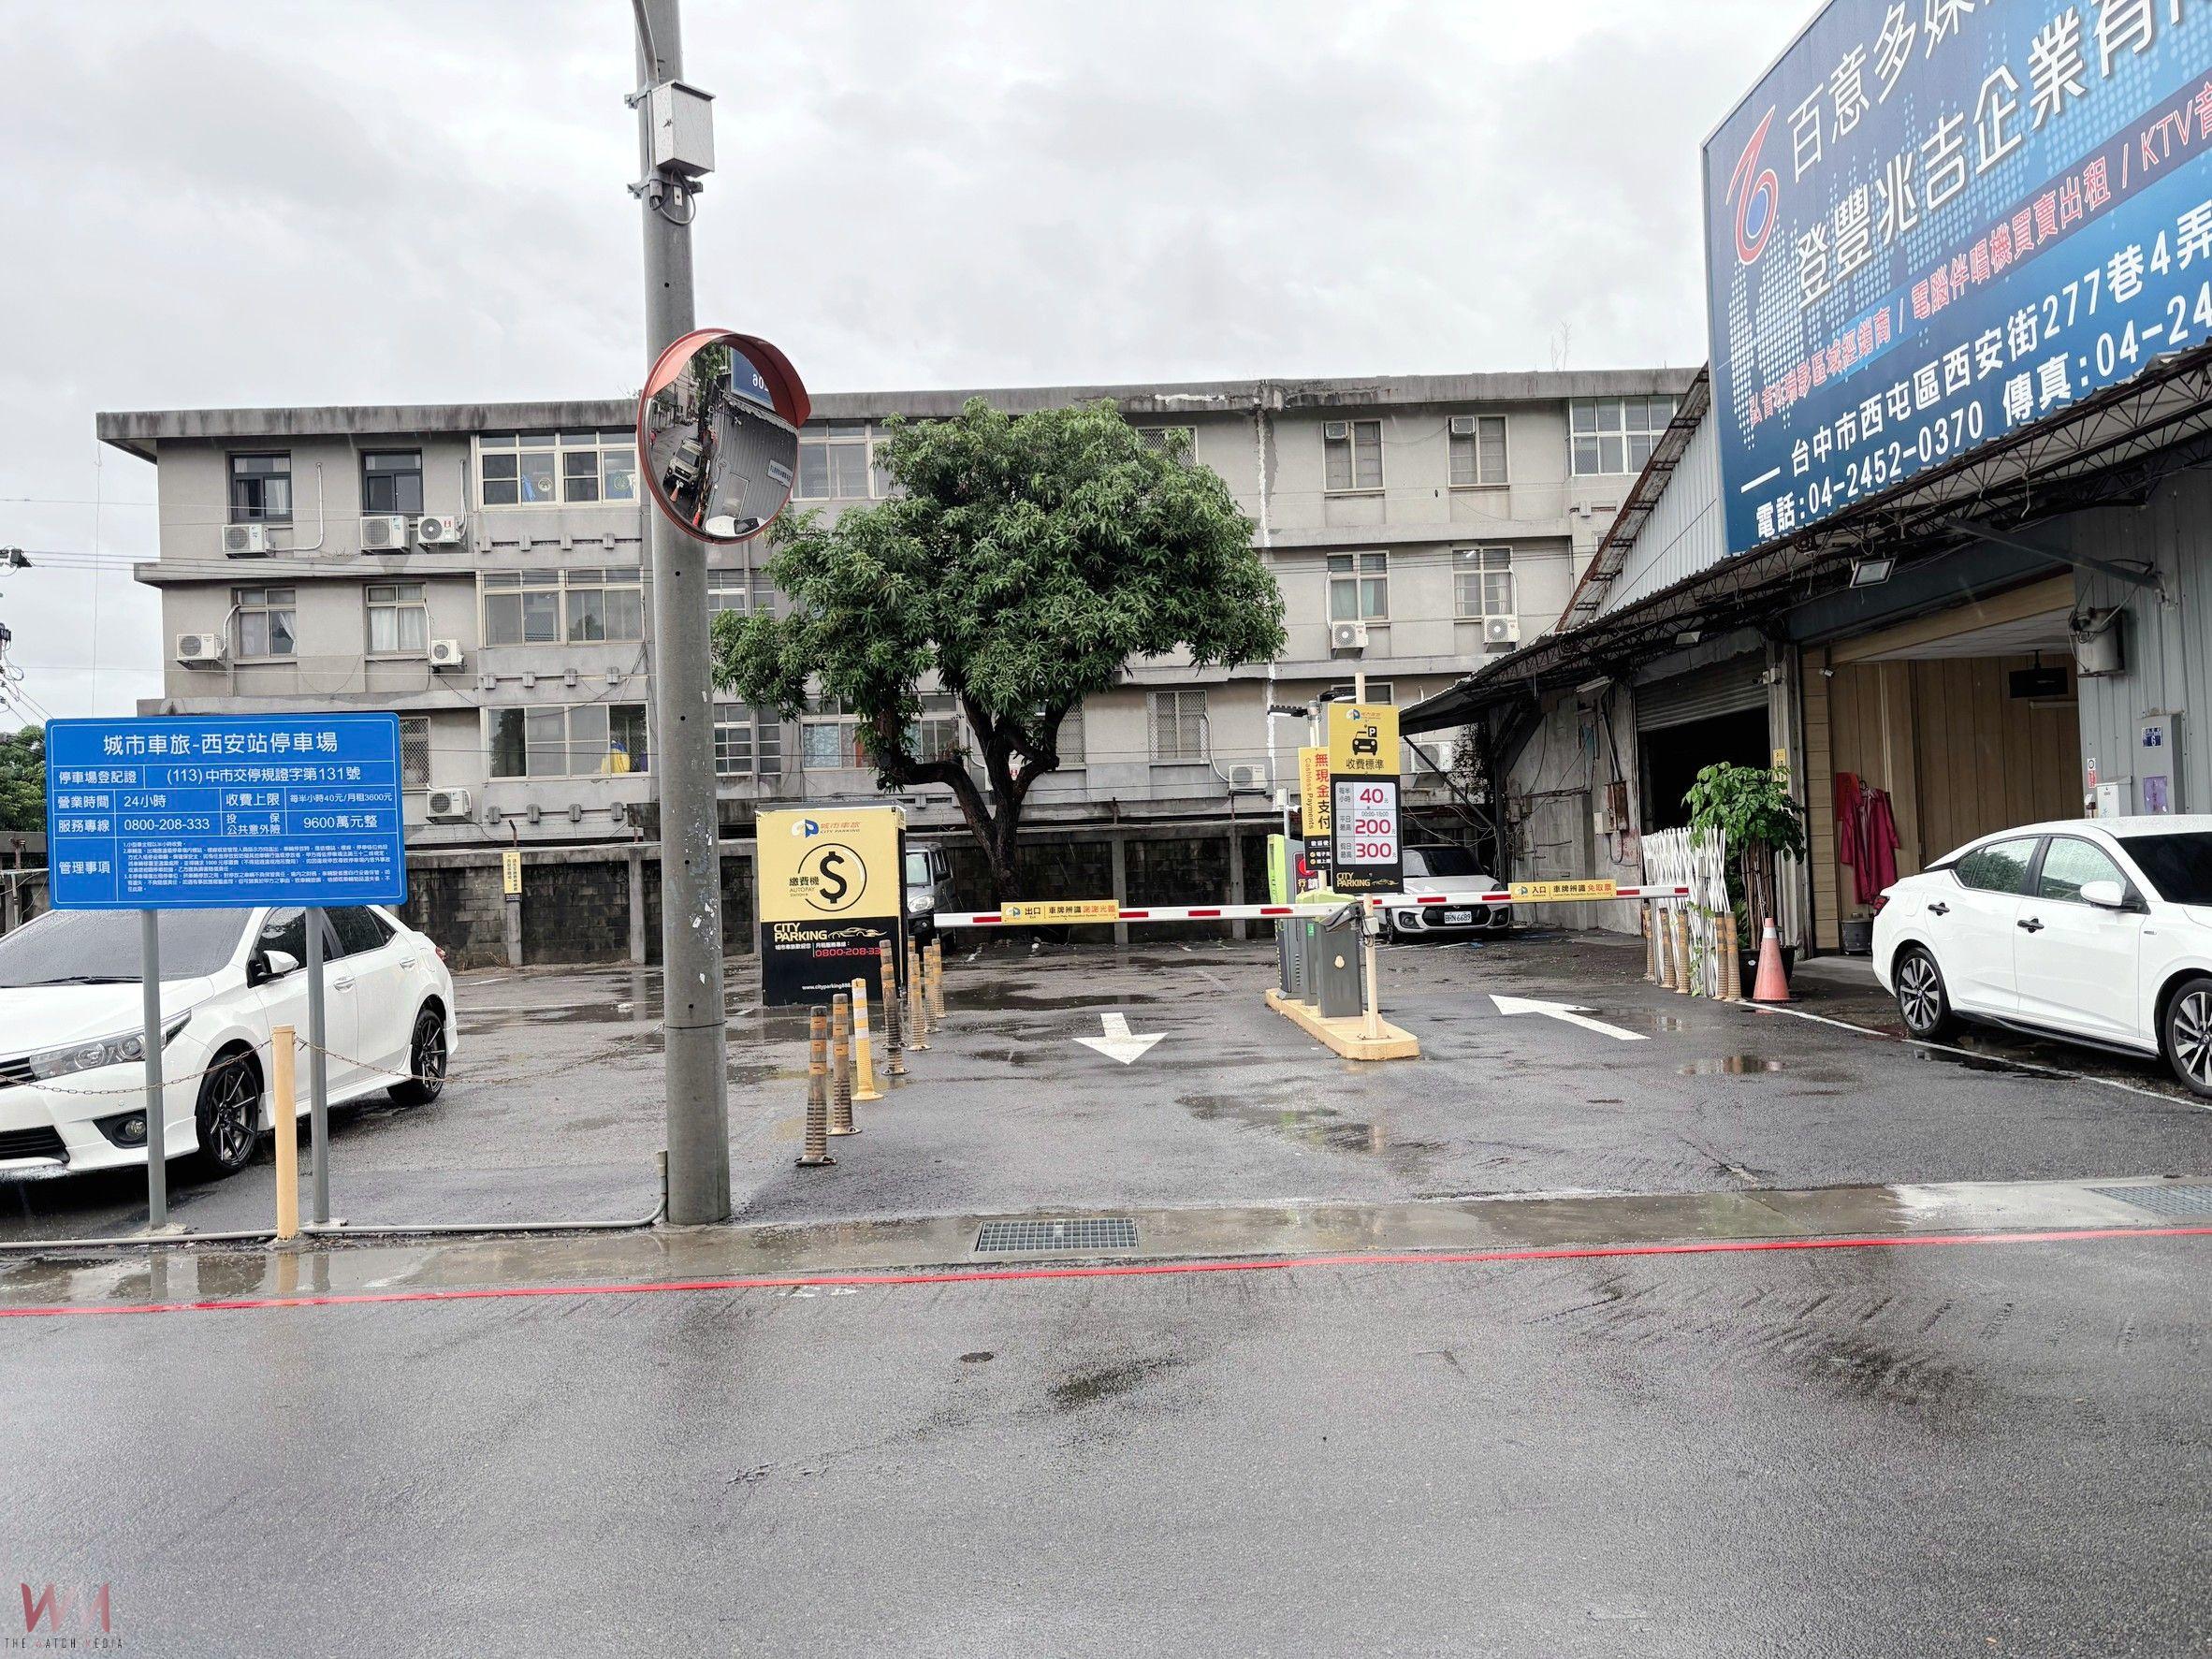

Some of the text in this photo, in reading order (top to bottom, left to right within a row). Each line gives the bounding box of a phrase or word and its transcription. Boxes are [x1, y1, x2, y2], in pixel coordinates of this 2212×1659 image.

[1788, 0, 1991, 183] 百意多媒
[1797, 0, 2179, 310] 登豐兆吉企業有
[1912, 155, 2111, 320] 電腦伴唱機買賣出租
[1792, 199, 2212, 477] 台中市西屯區西安街277巷4弄
[1756, 400, 1983, 538] 電話:04-2452-0370
[103, 732, 338, 755] 城市車旅-西安站停車場
[1346, 758, 1384, 770] 收費標準
[59, 766, 360, 785] 停車場登記證 (113)中市交停規證字第131號
[1316, 753, 1331, 829] 無現金支付
[1360, 789, 1384, 803] 40
[58, 795, 109, 808] 營業時間
[124, 794, 167, 808] 24小時
[226, 793, 280, 807] 收費上限
[58, 815, 378, 833] 服務專線 0800-208-333 9600萬元整
[226, 813, 280, 823] 投 保
[1355, 820, 1391, 834] 200
[1356, 843, 1391, 858] 300
[59, 861, 110, 875] 管理事項
[1337, 879, 1371, 887] PARKING
[1025, 907, 1041, 915] 出口
[774, 923, 800, 933] CITY
[775, 930, 828, 942] PARKING
[815, 948, 881, 957] 0800-208-33
